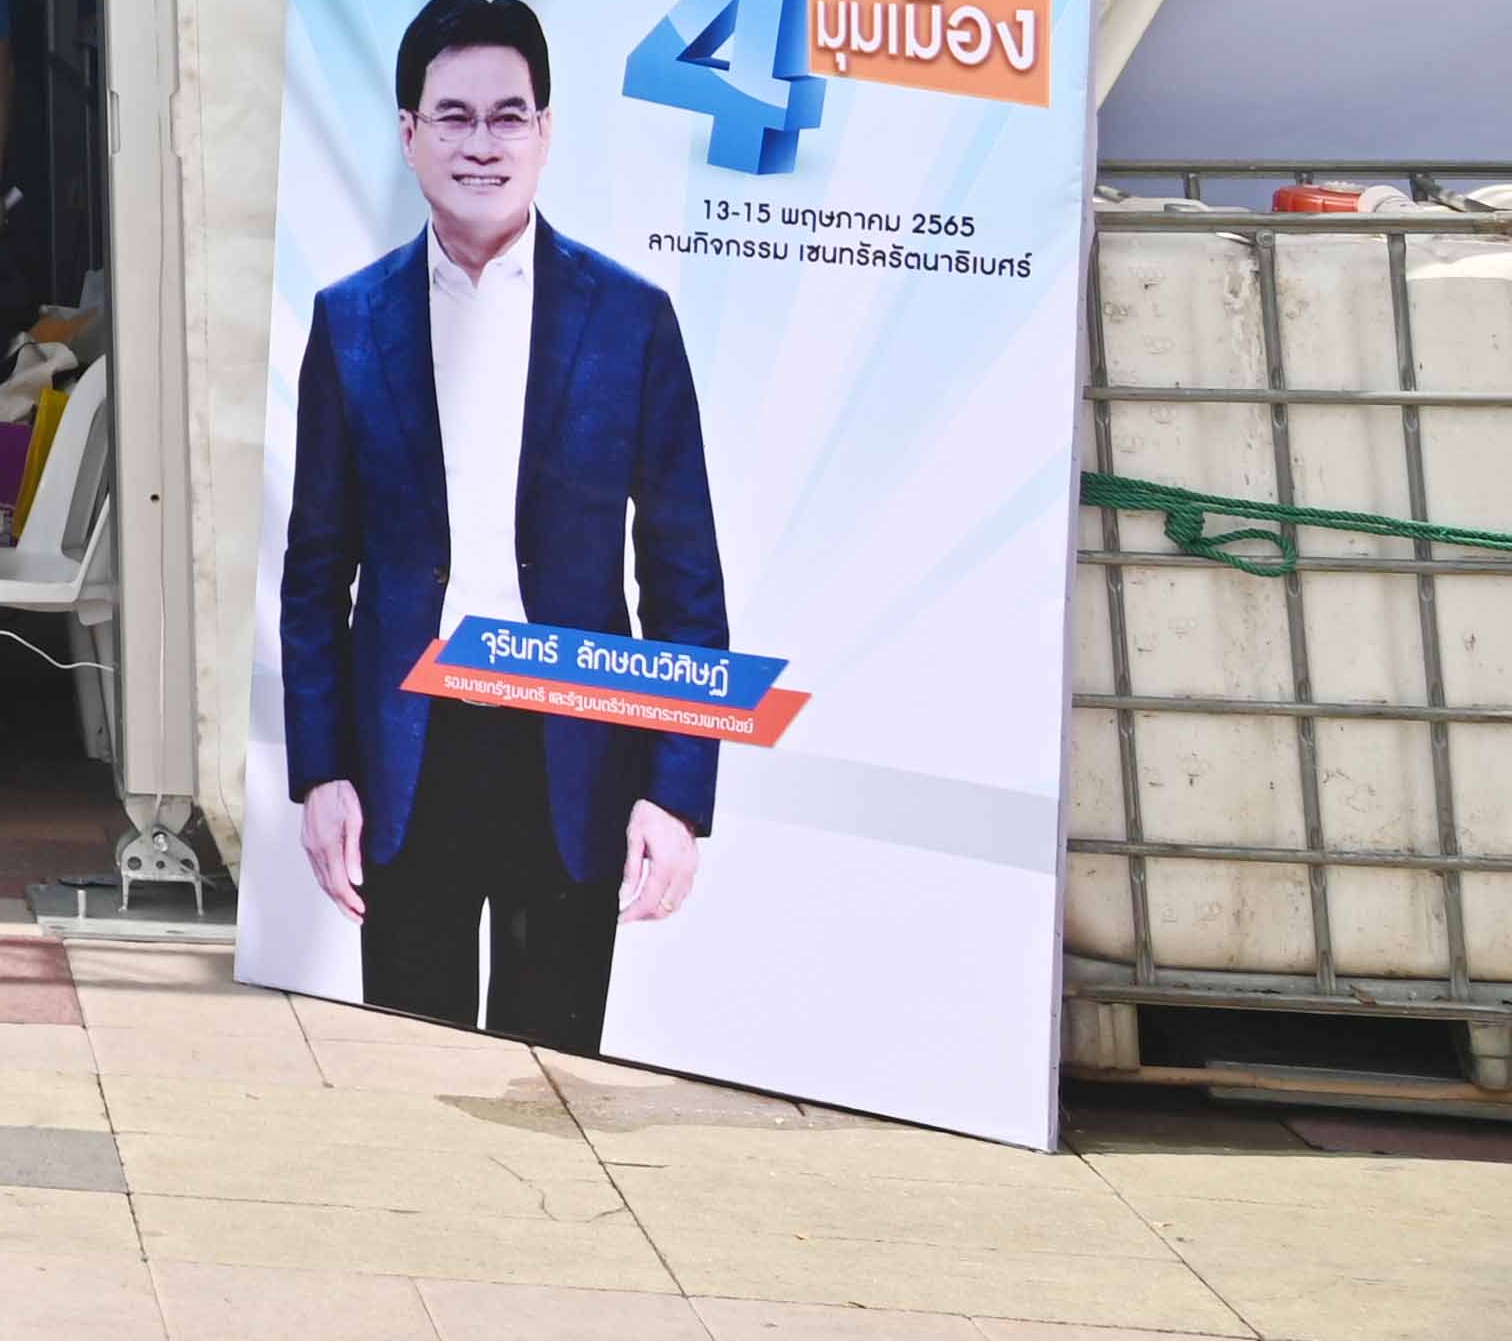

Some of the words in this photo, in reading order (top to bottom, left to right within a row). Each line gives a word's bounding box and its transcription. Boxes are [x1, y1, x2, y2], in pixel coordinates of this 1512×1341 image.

[702, 199, 772, 223] 13-15
[780, 206, 901, 233] พฤษภาคม
[911, 213, 976, 237] 2565
[647, 231, 789, 261] ลานกิจกรรม
[479, 629, 559, 664] จุรินทร์
[443, 673, 546, 703] รองนายกรัฐมนตรี
